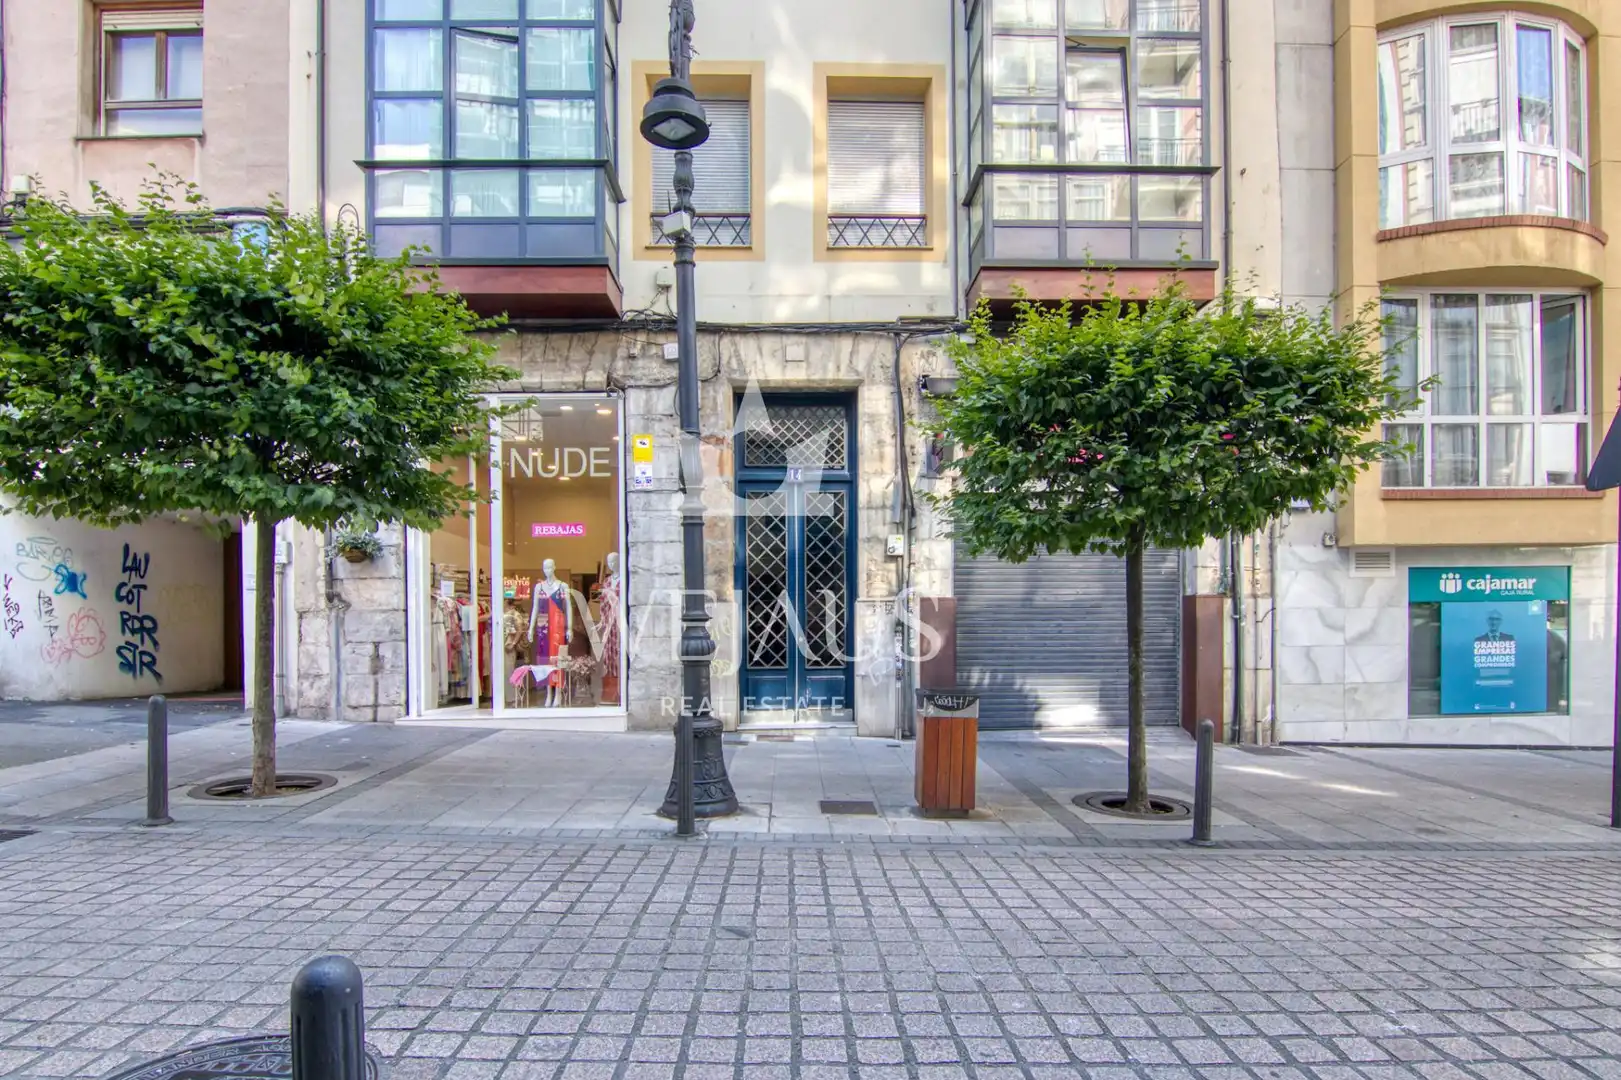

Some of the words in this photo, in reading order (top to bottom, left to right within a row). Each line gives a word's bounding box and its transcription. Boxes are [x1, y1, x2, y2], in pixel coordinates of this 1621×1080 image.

[510, 447, 611, 478] NUDE
[789, 468, 802, 480] 14
[534, 525, 583, 535] REBAJAS
[1466, 574, 1537, 594] cajamar
